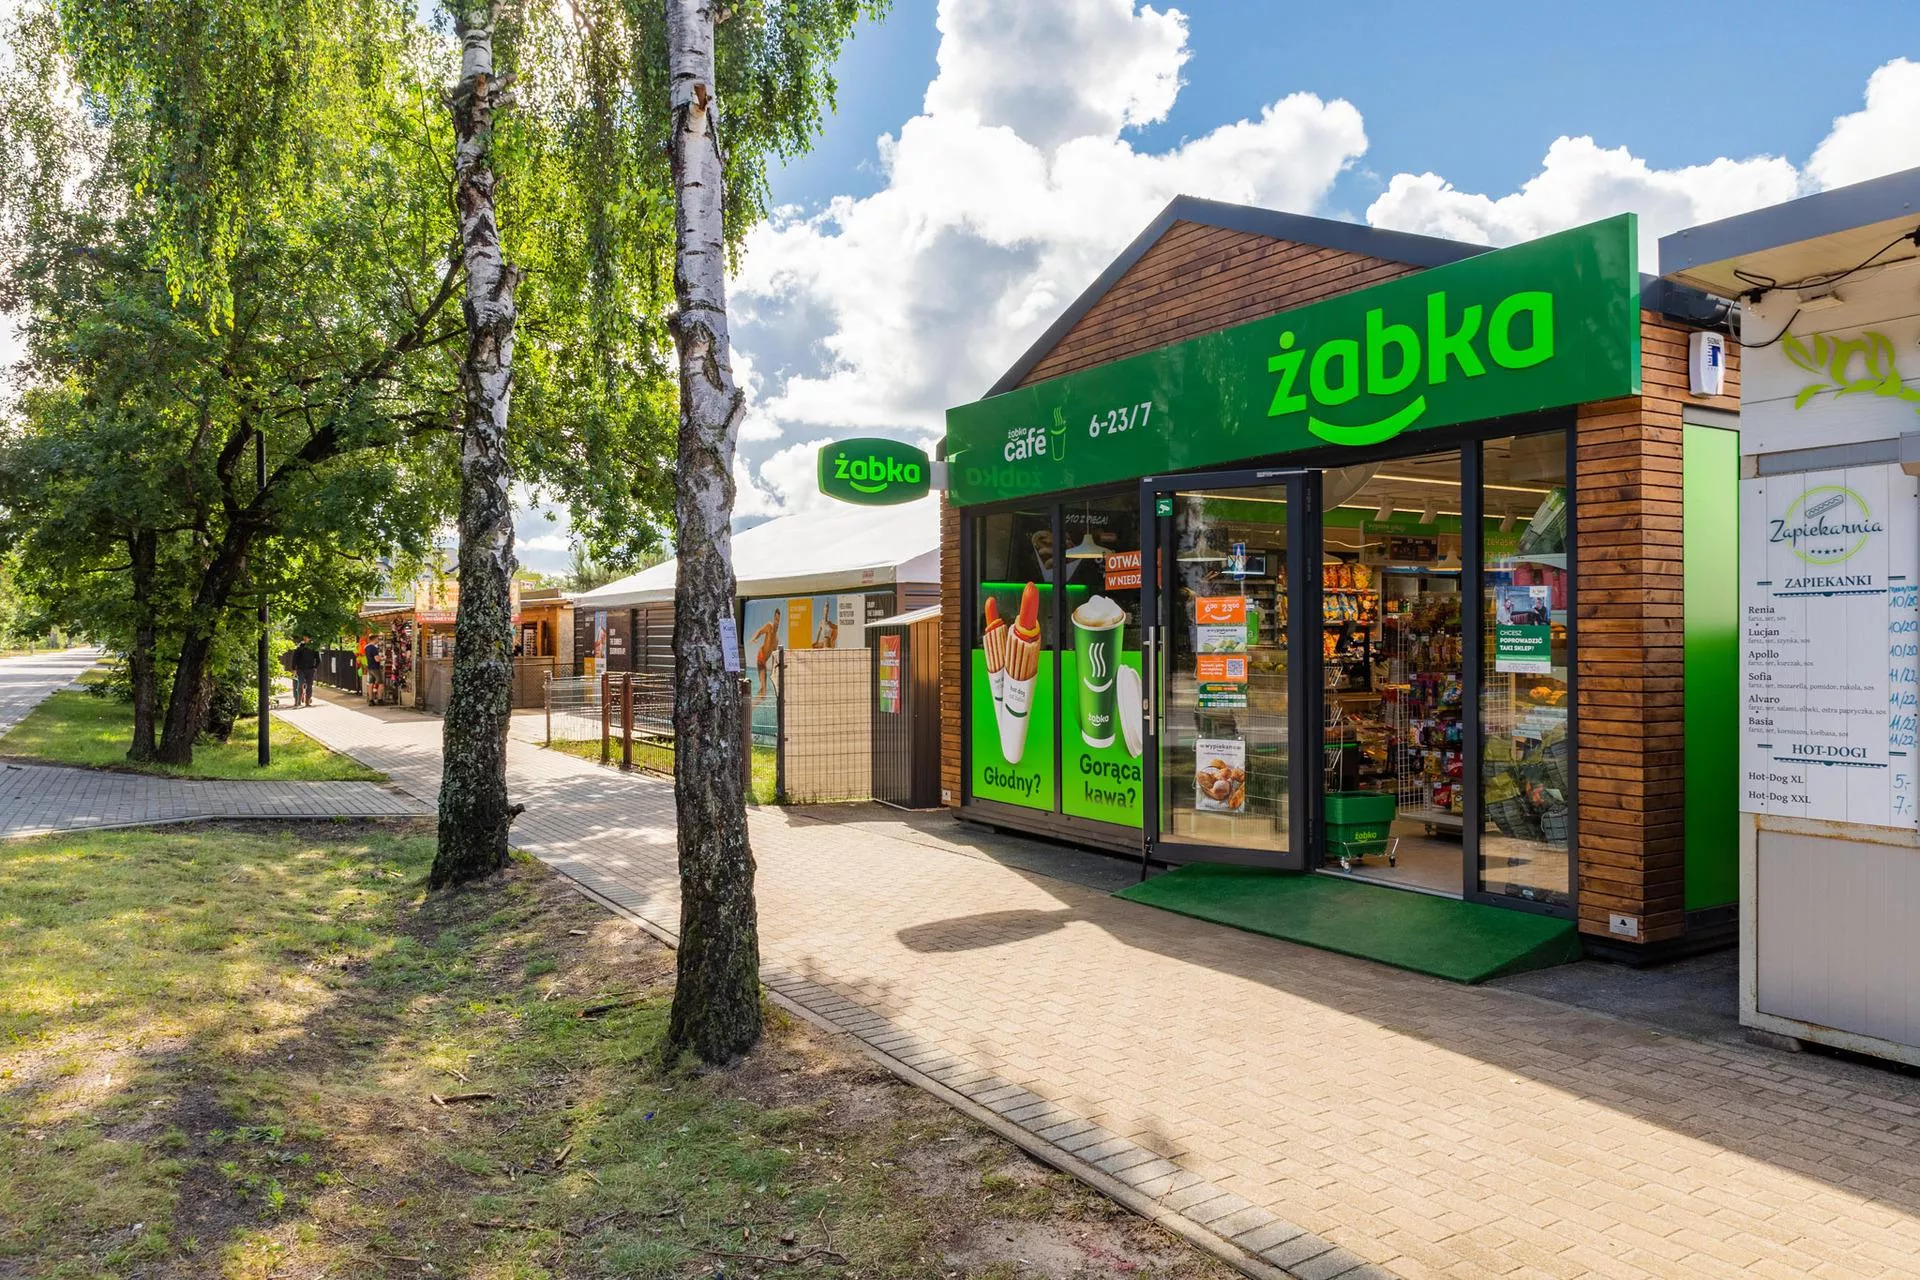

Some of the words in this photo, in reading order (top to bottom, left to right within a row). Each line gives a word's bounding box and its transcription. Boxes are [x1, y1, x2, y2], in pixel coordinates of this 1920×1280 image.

[1267, 291, 1554, 417] żabka
[1089, 402, 1151, 438] 6-23/7
[1008, 427, 1027, 440] żabka
[1004, 428, 1047, 462] café
[834, 453, 920, 484] żabka
[1769, 516, 1884, 548] Zapiekarnia
[1108, 554, 1141, 569] OTWA
[1108, 577, 1117, 587] W
[1784, 575, 1872, 589] ZAPIEKANKI
[1748, 605, 1775, 614] Renia
[1748, 628, 1780, 638] Lucjan
[1748, 650, 1779, 660] Apollo
[1748, 672, 1772, 681] Sofia
[1748, 694, 1780, 704] Alvaro
[1748, 717, 1774, 726] Basia
[1792, 744, 1868, 759] HOT-DOGI
[1079, 754, 1141, 784] Gorąca
[984, 766, 1041, 798] Głodny?
[1748, 772, 1788, 785] Hot-Dog
[1791, 775, 1804, 784] XL
[1085, 781, 1136, 809] kawa?
[1748, 791, 1788, 804] Hot-Dog
[1791, 794, 1812, 804] XXL
